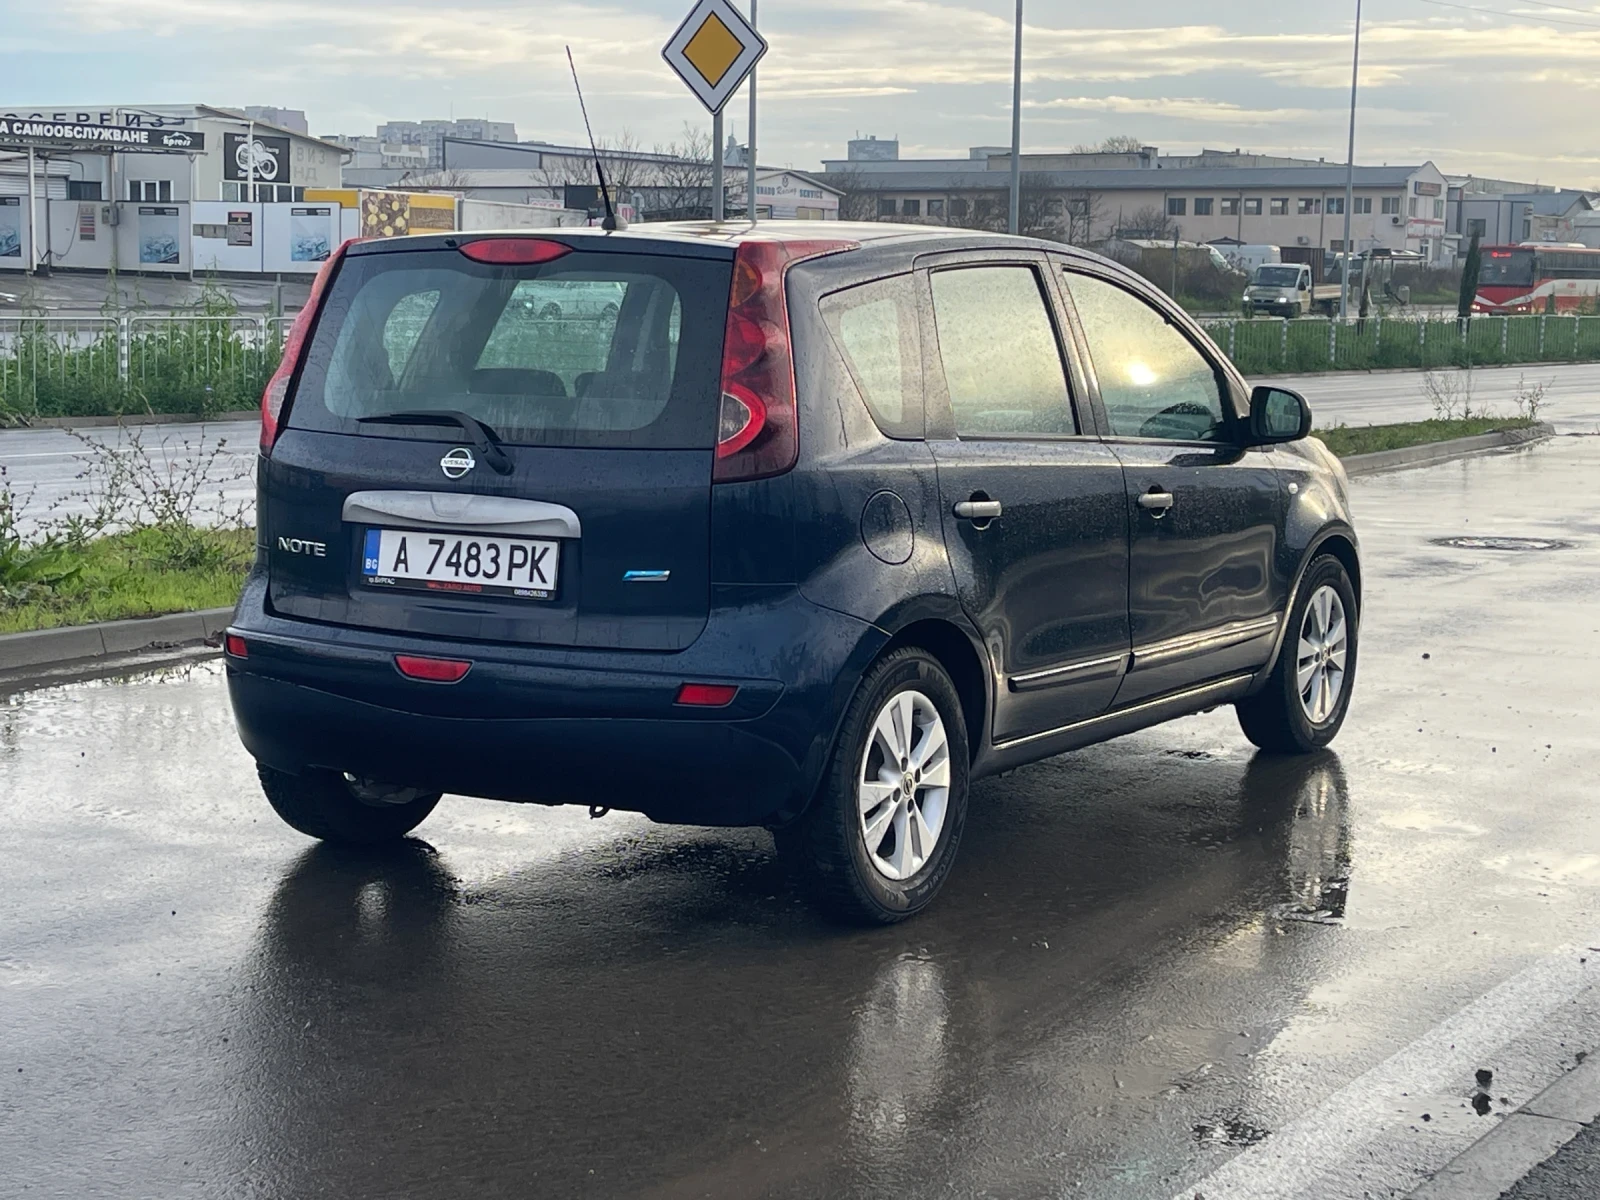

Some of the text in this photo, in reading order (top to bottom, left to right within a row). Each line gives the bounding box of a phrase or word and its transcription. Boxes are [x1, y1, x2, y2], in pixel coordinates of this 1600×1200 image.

[13, 122, 148, 143] САМООБСЛУЖВАНЕ
[799, 188, 823, 199] SERVICE
[278, 536, 327, 557] NOTE
[365, 558, 378, 570] BG
[393, 537, 550, 584] A 7483 PK
